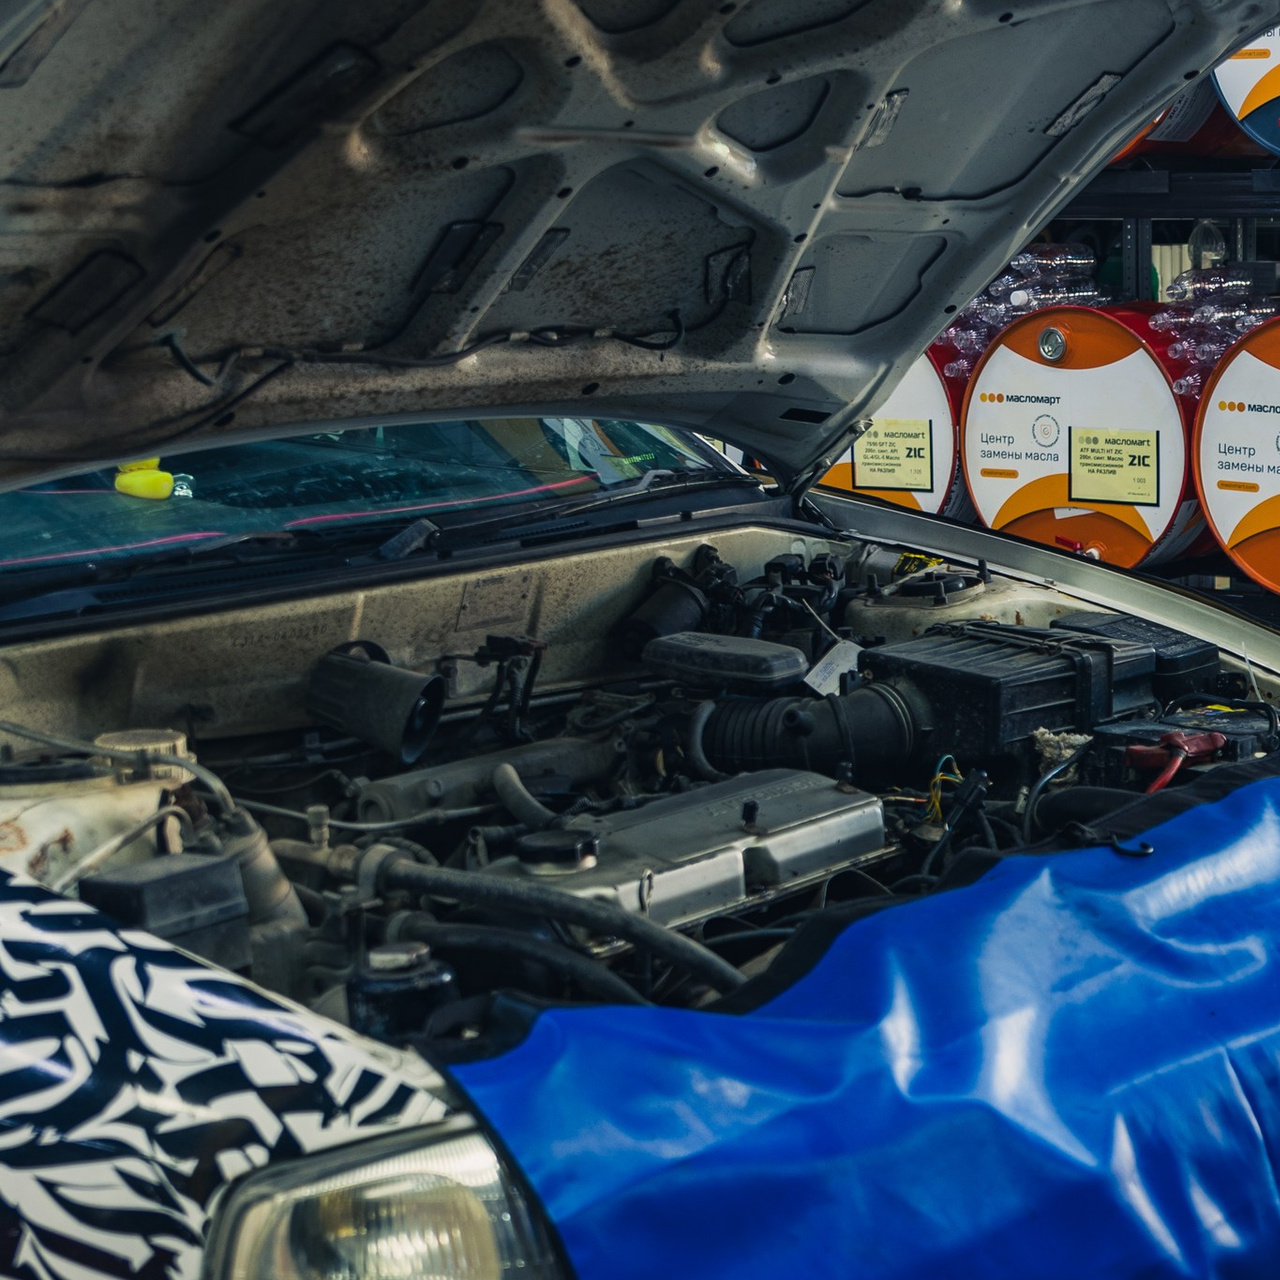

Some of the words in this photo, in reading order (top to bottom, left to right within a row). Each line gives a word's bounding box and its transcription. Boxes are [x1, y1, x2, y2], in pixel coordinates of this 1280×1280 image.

[1006, 394, 1061, 406] масломарт
[980, 433, 1015, 445] Центр
[905, 447, 925, 458] ZIC
[980, 449, 1022, 460] замены
[1025, 452, 1059, 461] масла
[1218, 443, 1256, 457] Центр
[1128, 455, 1150, 467] ZIC
[1217, 460, 1264, 473] замены
